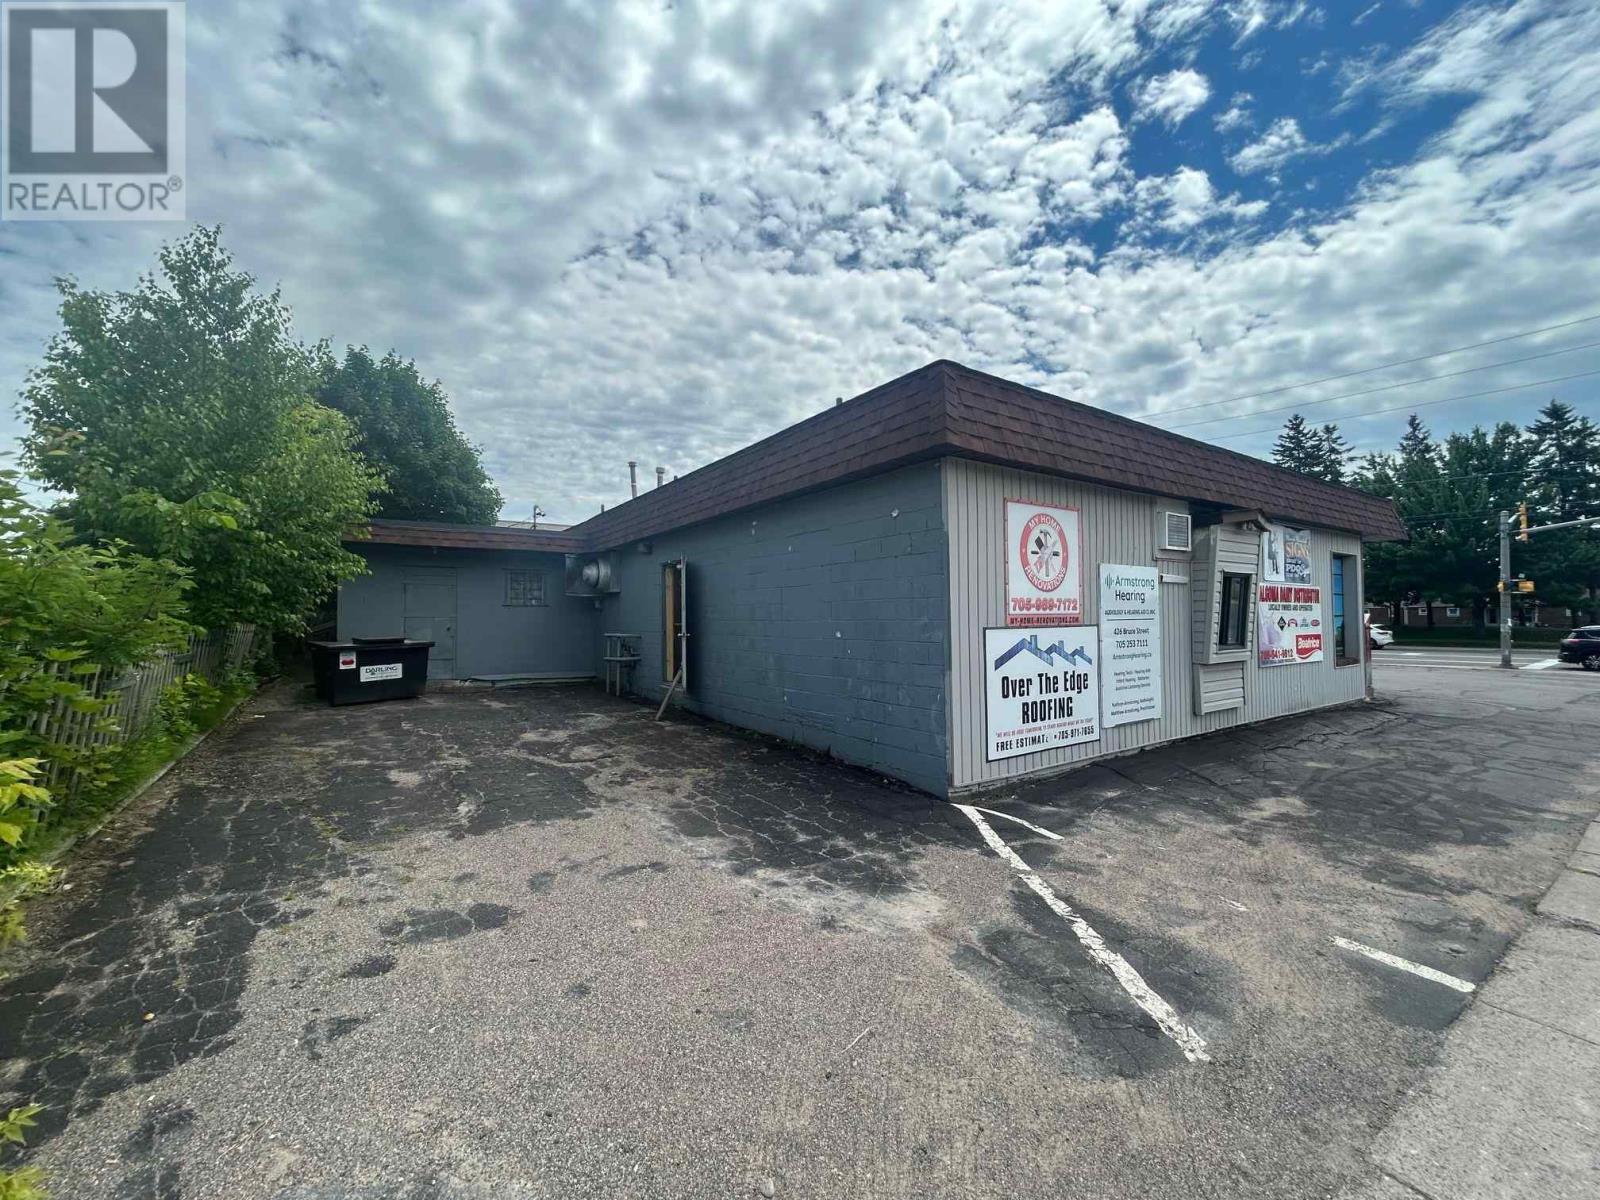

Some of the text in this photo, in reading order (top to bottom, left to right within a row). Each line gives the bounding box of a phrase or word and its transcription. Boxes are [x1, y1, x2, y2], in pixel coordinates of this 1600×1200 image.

[1029, 515, 1060, 530] MY HOME
[1025, 566, 1066, 590] RENOVATIONS
[1115, 575, 1154, 590] Armstrong
[1115, 590, 1145, 603] Hearing
[1115, 640, 1126, 648] 705
[365, 666, 397, 674] DARLING
[1001, 670, 1088, 699] Over The Edge
[1022, 697, 1073, 724] ROOFING
[996, 739, 1013, 752] FREE
